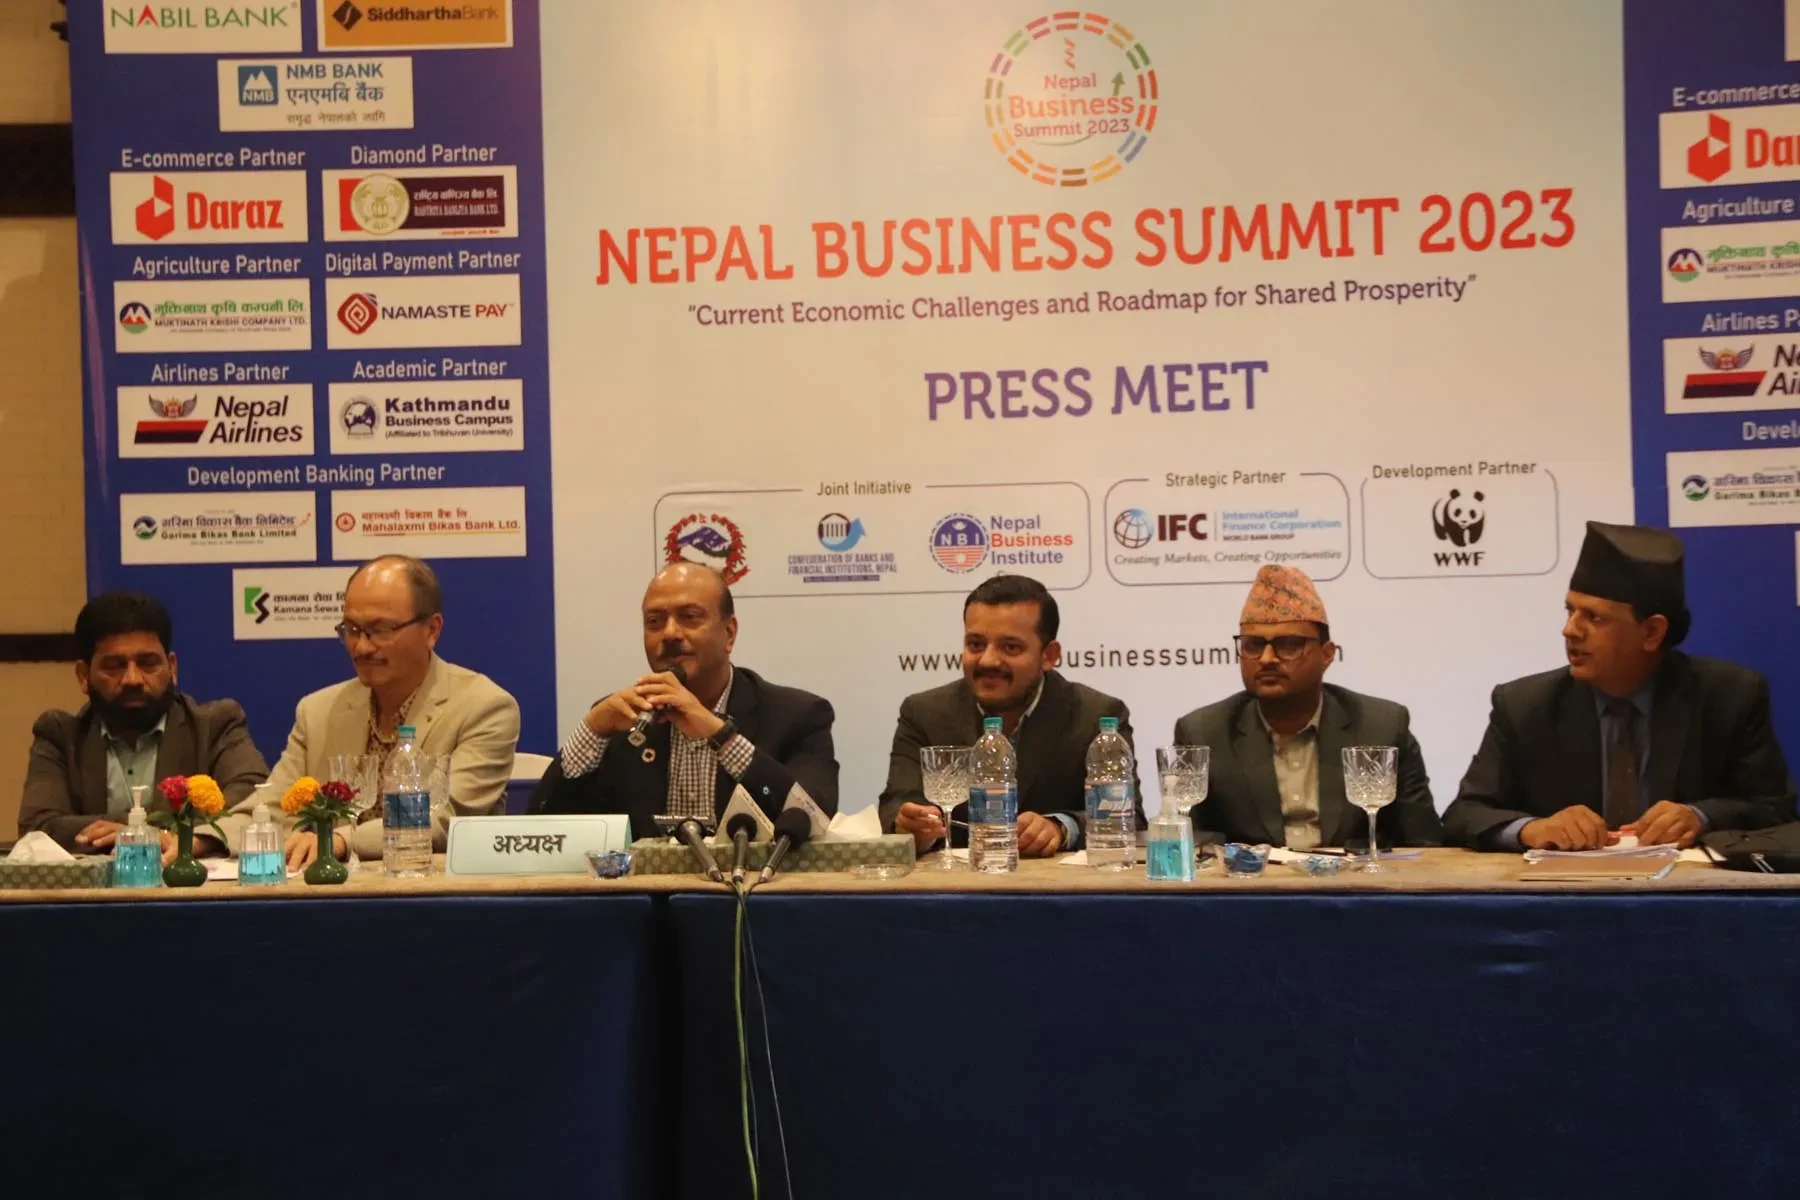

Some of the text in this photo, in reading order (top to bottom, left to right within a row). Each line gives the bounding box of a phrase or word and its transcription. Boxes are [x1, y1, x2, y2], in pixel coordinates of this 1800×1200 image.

[111, 4, 288, 28] NABIL BANK
[287, 63, 383, 79] NMB BANK
[1044, 73, 1097, 91] Nepal
[243, 88, 274, 103] NMB
[1672, 83, 1800, 107] E-commerce
[1007, 95, 1134, 119] Business
[1013, 118, 1130, 138] Summit 2023
[121, 147, 306, 168] E-commerce Partner
[351, 143, 498, 164] Diamond Partner
[186, 192, 284, 230] Daraz
[1682, 196, 1795, 223] Agriculture
[596, 187, 1575, 286] NEPAL BUSINESS SUMMIT 2023
[132, 254, 302, 279] Agriculture Partner
[325, 250, 521, 276] Digital Payment Partner
[381, 303, 507, 320] NAMASTE PAY
[792, 299, 905, 324] Economic
[911, 295, 1039, 322] Challenges
[1046, 292, 1090, 315] and
[1097, 288, 1207, 314] Roadmap
[1214, 285, 1248, 308] for
[1254, 281, 1336, 306] Shared
[154, 318, 207, 327] MUKTINATH
[210, 317, 239, 326] KRISHI
[242, 316, 286, 326] COMPANY
[1701, 312, 1779, 332] Airlines
[151, 362, 290, 382] Airlines Partner
[353, 357, 507, 378] Academic Partner
[924, 360, 1268, 421] PRESS MEET
[214, 395, 289, 421] Nepal
[385, 395, 510, 413] Kathmandu
[385, 413, 513, 428] Business Campus
[209, 419, 303, 444] Airlines
[188, 463, 445, 488] Development Banking Partner
[1166, 470, 1287, 489] Strategic Partner
[1372, 461, 1537, 479] Development Partner
[817, 480, 911, 496] Joint Initiative
[990, 515, 1041, 532] Nepal
[1222, 509, 1299, 519] International
[161, 528, 297, 540] Garima Bikas Bank Limited
[362, 519, 520, 532] Mahalaxmi Bikas Bank Ltd.
[1158, 513, 1207, 541] IFC
[1222, 520, 1342, 531] Finance Corporation
[991, 533, 1073, 547] Business
[991, 550, 1063, 565] Institute
[1114, 554, 1160, 566] Creating
[1214, 551, 1260, 564] Creating
[1264, 549, 1342, 562] Opportunities
[1433, 551, 1485, 566] WWF
[273, 605, 312, 614] Kamana
[314, 604, 340, 613] Sewa
[493, 834, 567, 854] अध्यक्ष
